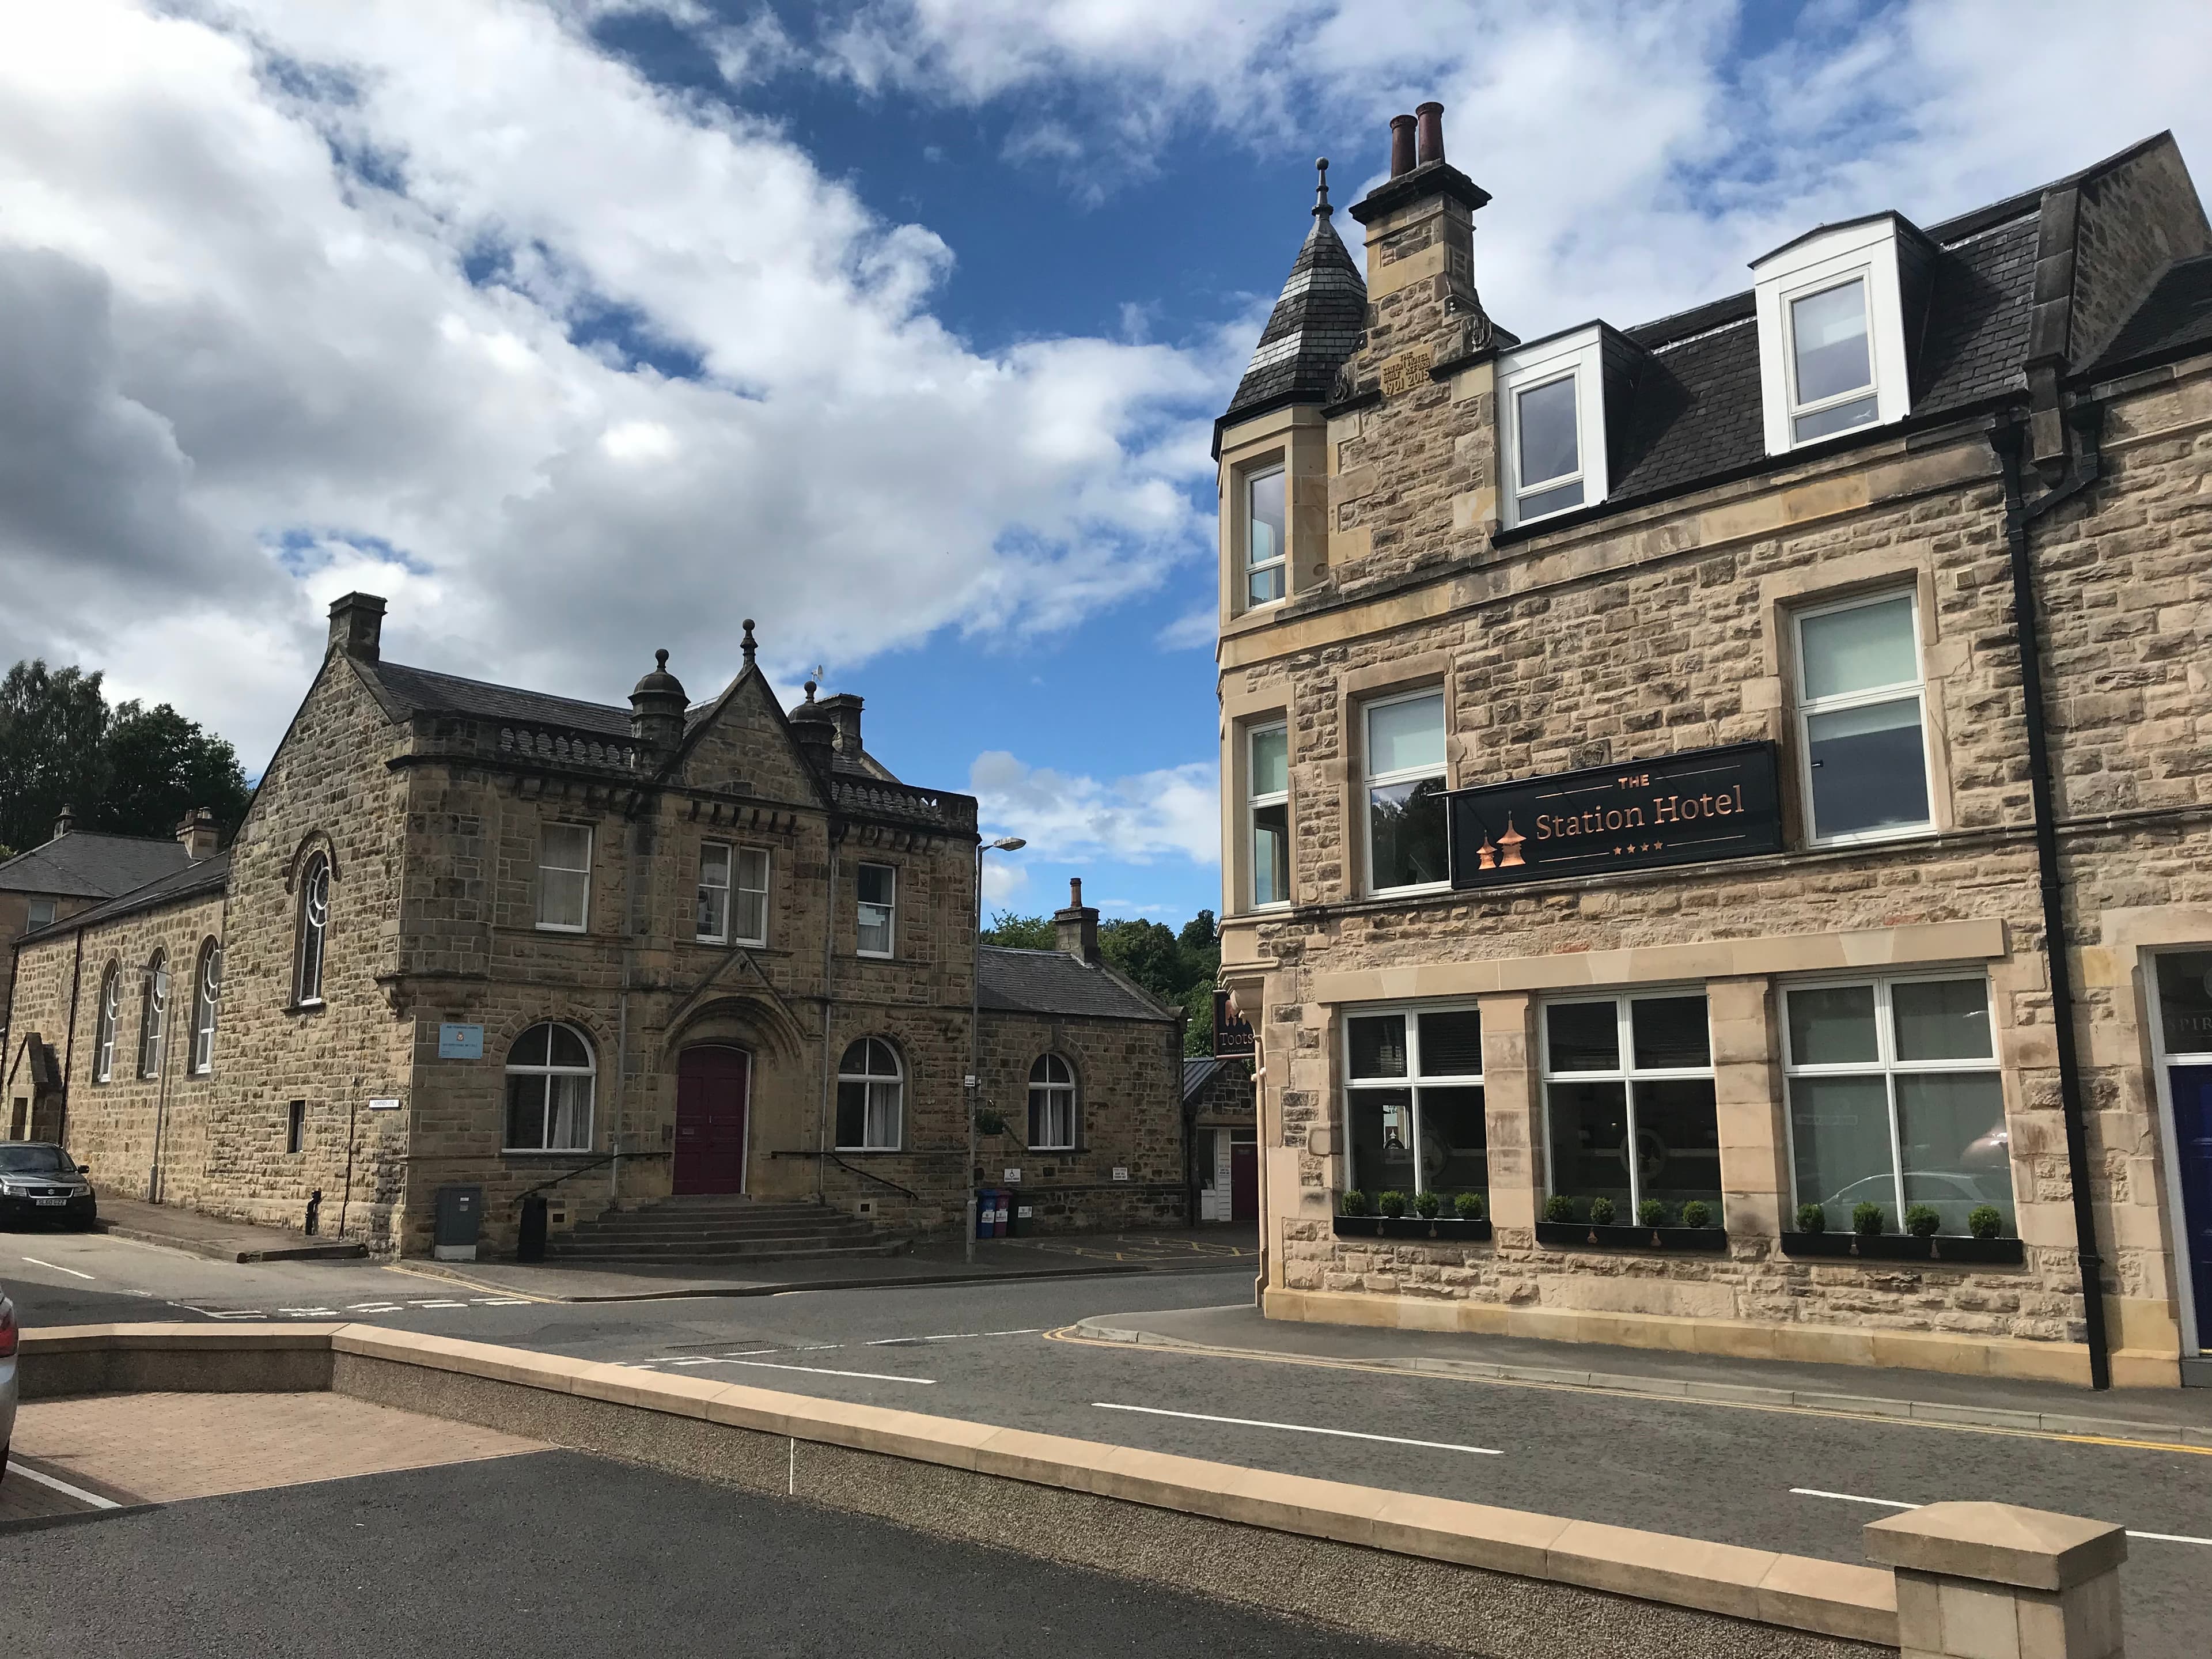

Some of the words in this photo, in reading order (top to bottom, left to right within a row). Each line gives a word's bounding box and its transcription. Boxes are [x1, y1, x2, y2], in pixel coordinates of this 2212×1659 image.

[1400, 351, 1413, 361] THE
[1407, 353, 1429, 367] HOTEL
[1384, 371, 1401, 384] BUILT
[1387, 378, 1404, 395] 1901
[1408, 369, 1430, 387] 2015
[1618, 774, 1650, 790] THE
[1536, 805, 1645, 840] Station
[1653, 785, 1745, 824] Hotel
[1219, 1032, 1253, 1046] Toots
